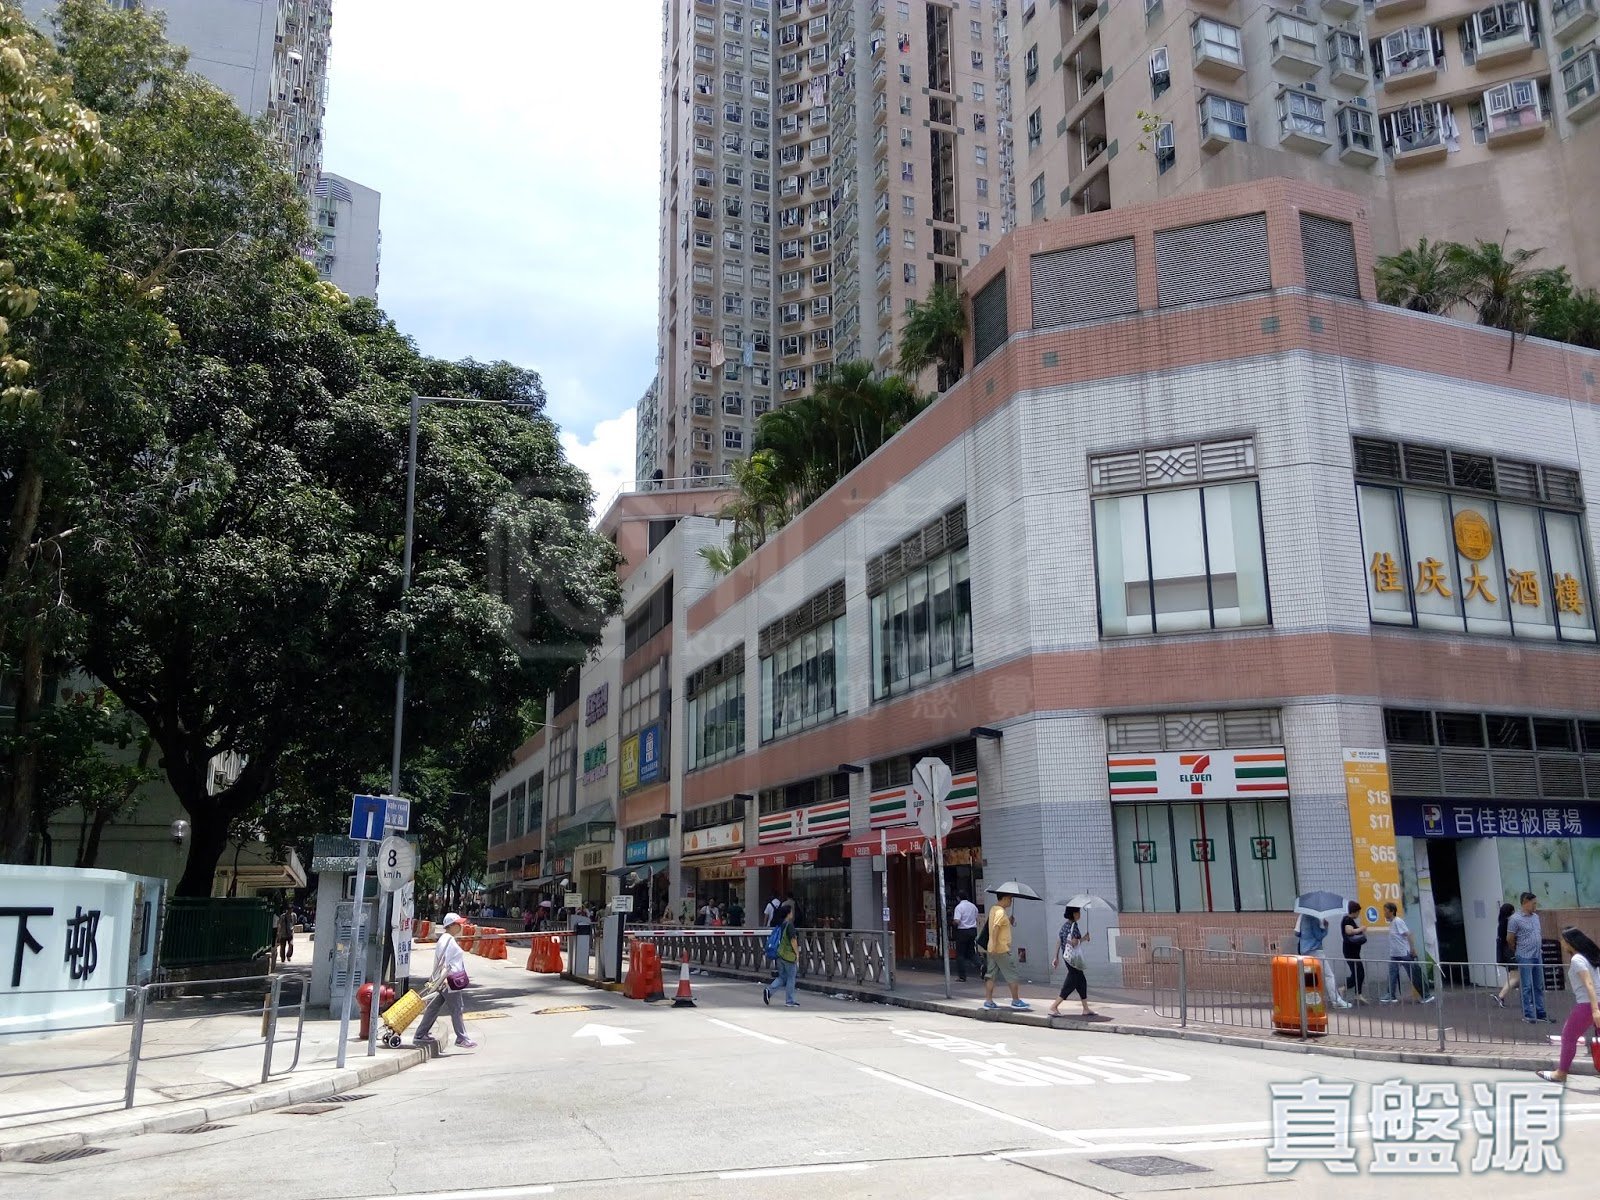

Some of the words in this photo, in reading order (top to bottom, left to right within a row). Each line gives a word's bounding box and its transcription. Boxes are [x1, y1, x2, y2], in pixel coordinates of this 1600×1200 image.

[1367, 789, 1389, 805] $15
[1369, 814, 1390, 830] $17
[1453, 807, 1583, 835] 百佳超級廣場
[387, 848, 398, 868] 8
[1370, 845, 1397, 864] $65
[383, 869, 402, 880] km/h
[1373, 882, 1401, 902] $70
[0, 906, 101, 987] 下邨
